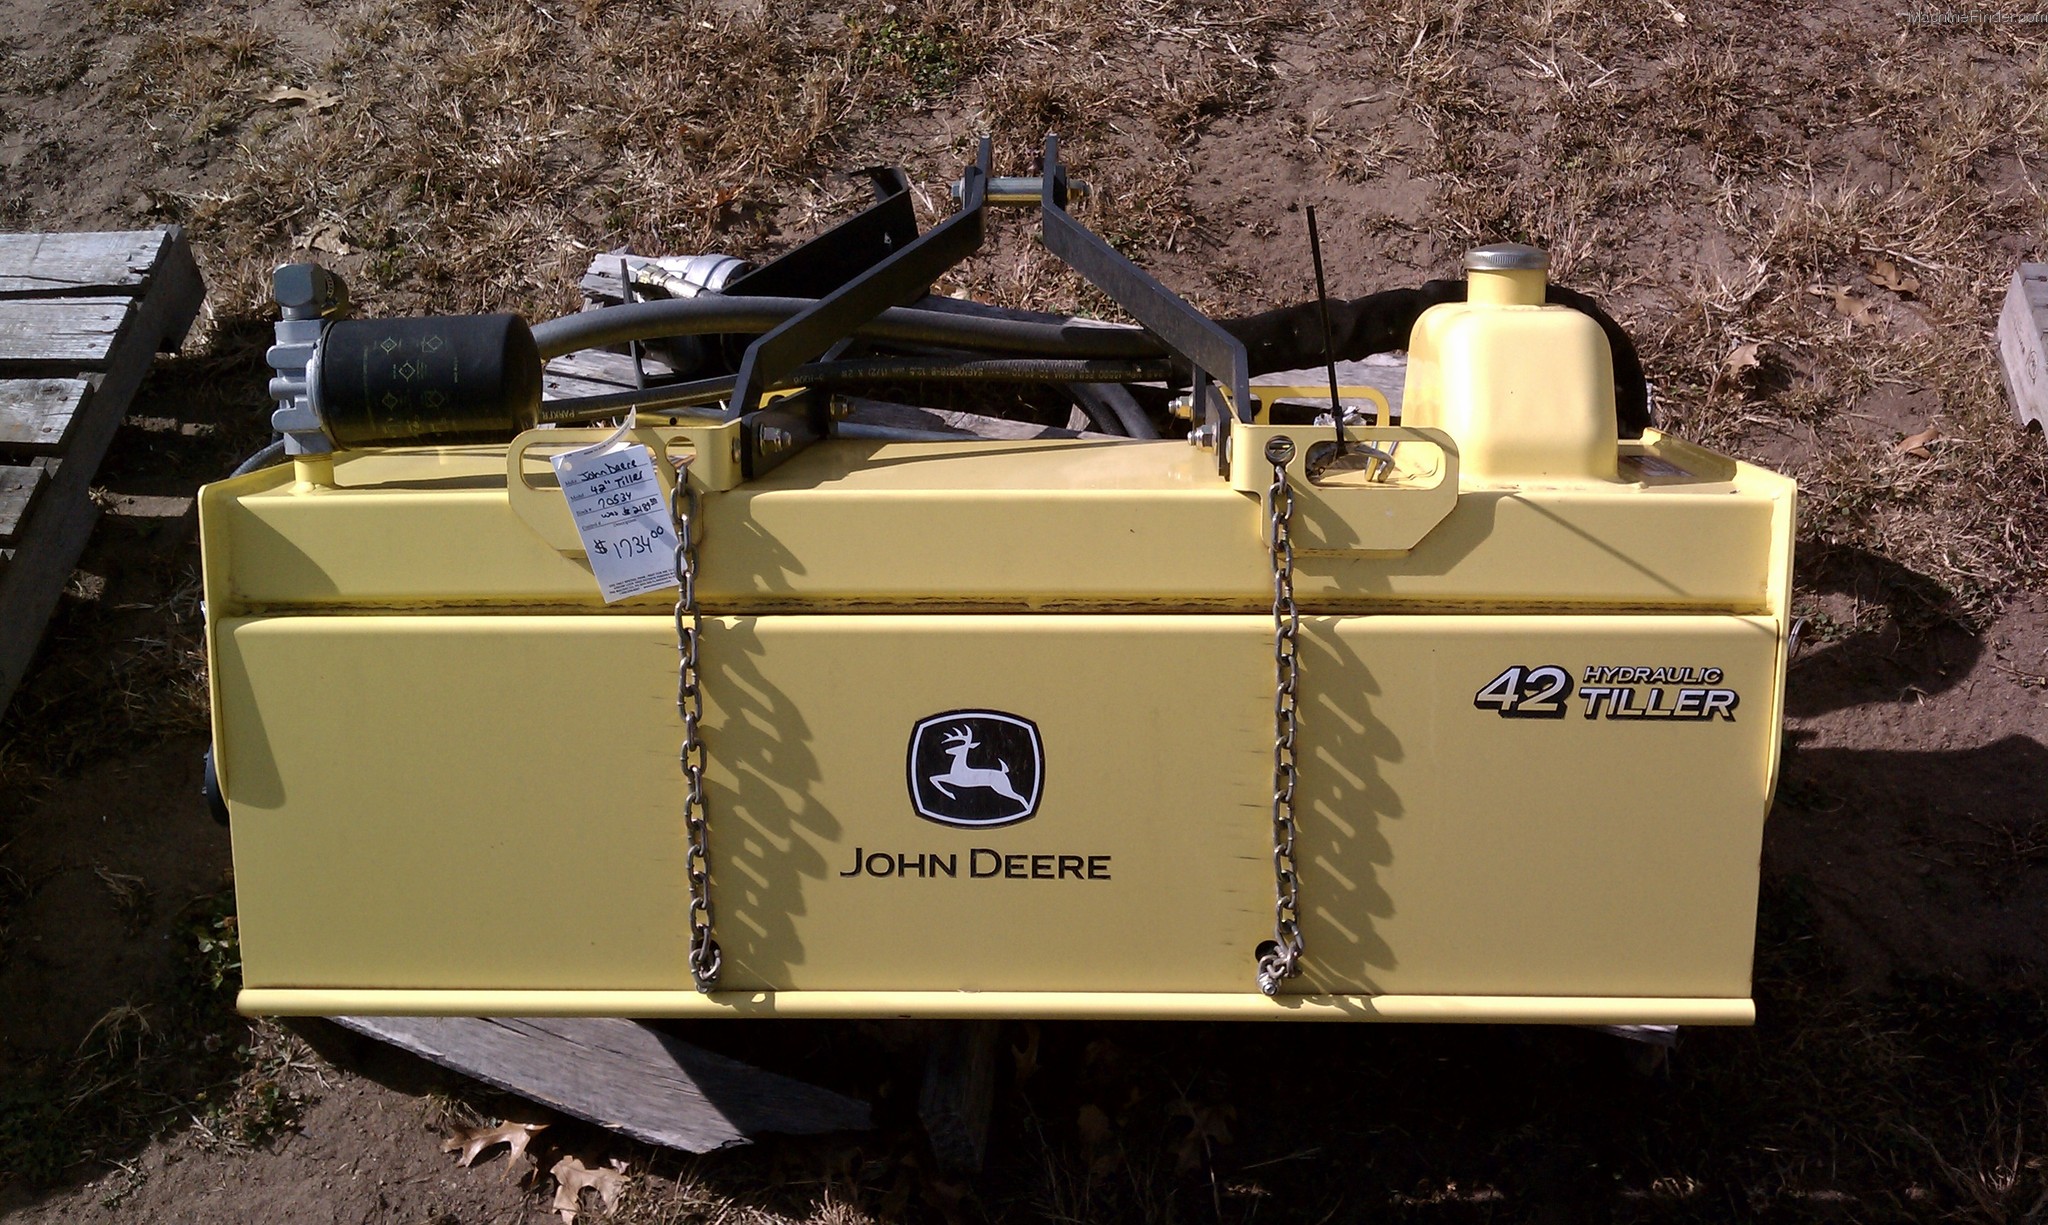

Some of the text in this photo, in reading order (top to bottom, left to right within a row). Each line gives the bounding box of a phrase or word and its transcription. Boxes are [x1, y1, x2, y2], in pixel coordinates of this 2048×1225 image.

[614, 470, 644, 489] Tiller
[1582, 665, 1724, 685] HYDRAULIC
[1474, 665, 1574, 720] 42
[1578, 687, 1740, 722] TILLER
[840, 847, 1111, 880] JOHN DEERE
